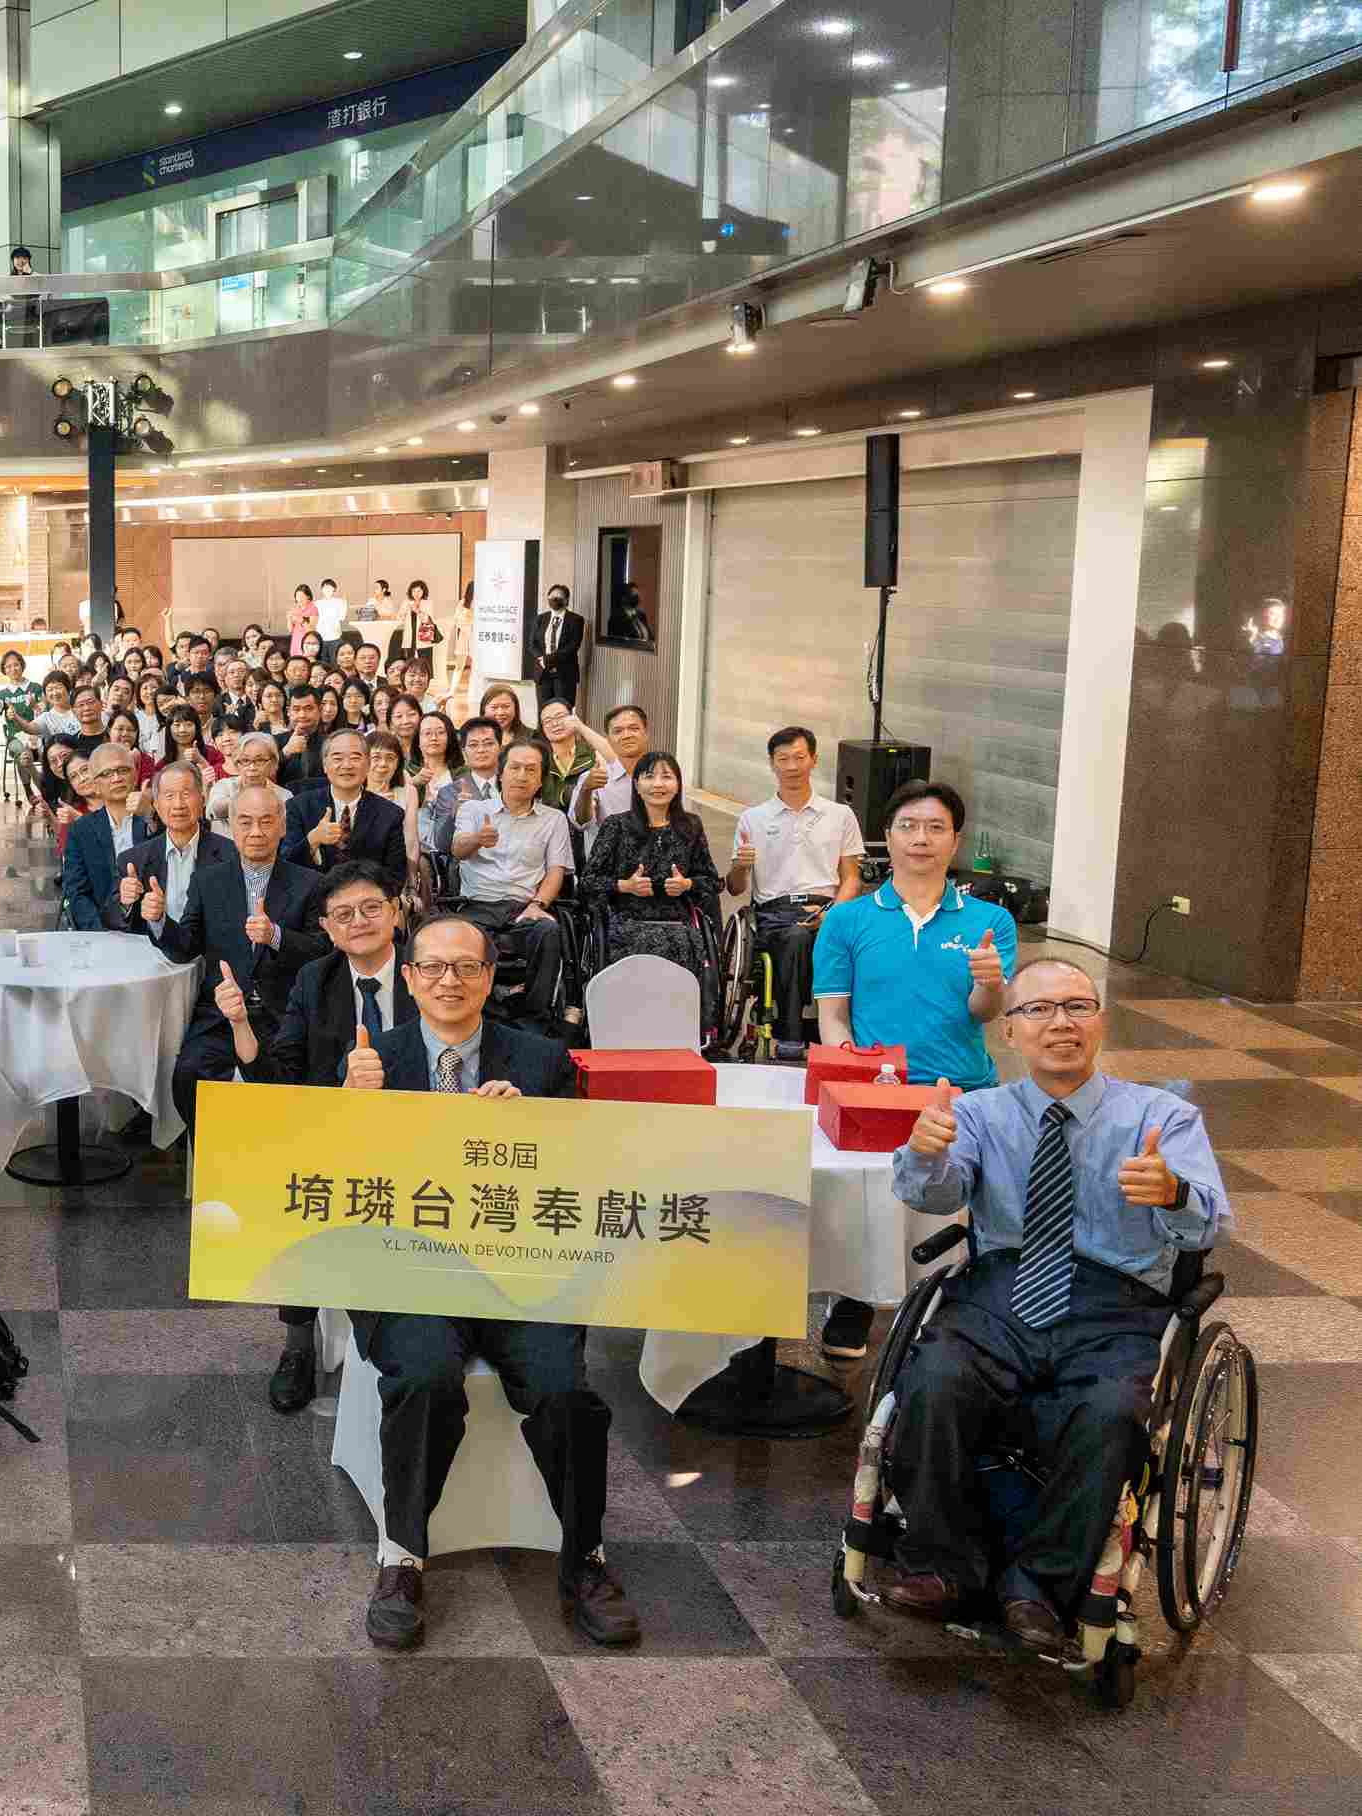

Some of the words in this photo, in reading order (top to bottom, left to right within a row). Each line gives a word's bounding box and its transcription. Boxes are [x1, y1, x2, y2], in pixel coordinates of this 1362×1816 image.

[327, 96, 387, 128] 渣打銀行
[462, 1137, 539, 1171] 第8屆
[284, 1171, 712, 1245] 堉璘台灣奉獻獎
[409, 1239, 469, 1256] TAIWAN
[474, 1244, 553, 1261] DEVOTION
[557, 1251, 616, 1264] AWARD
